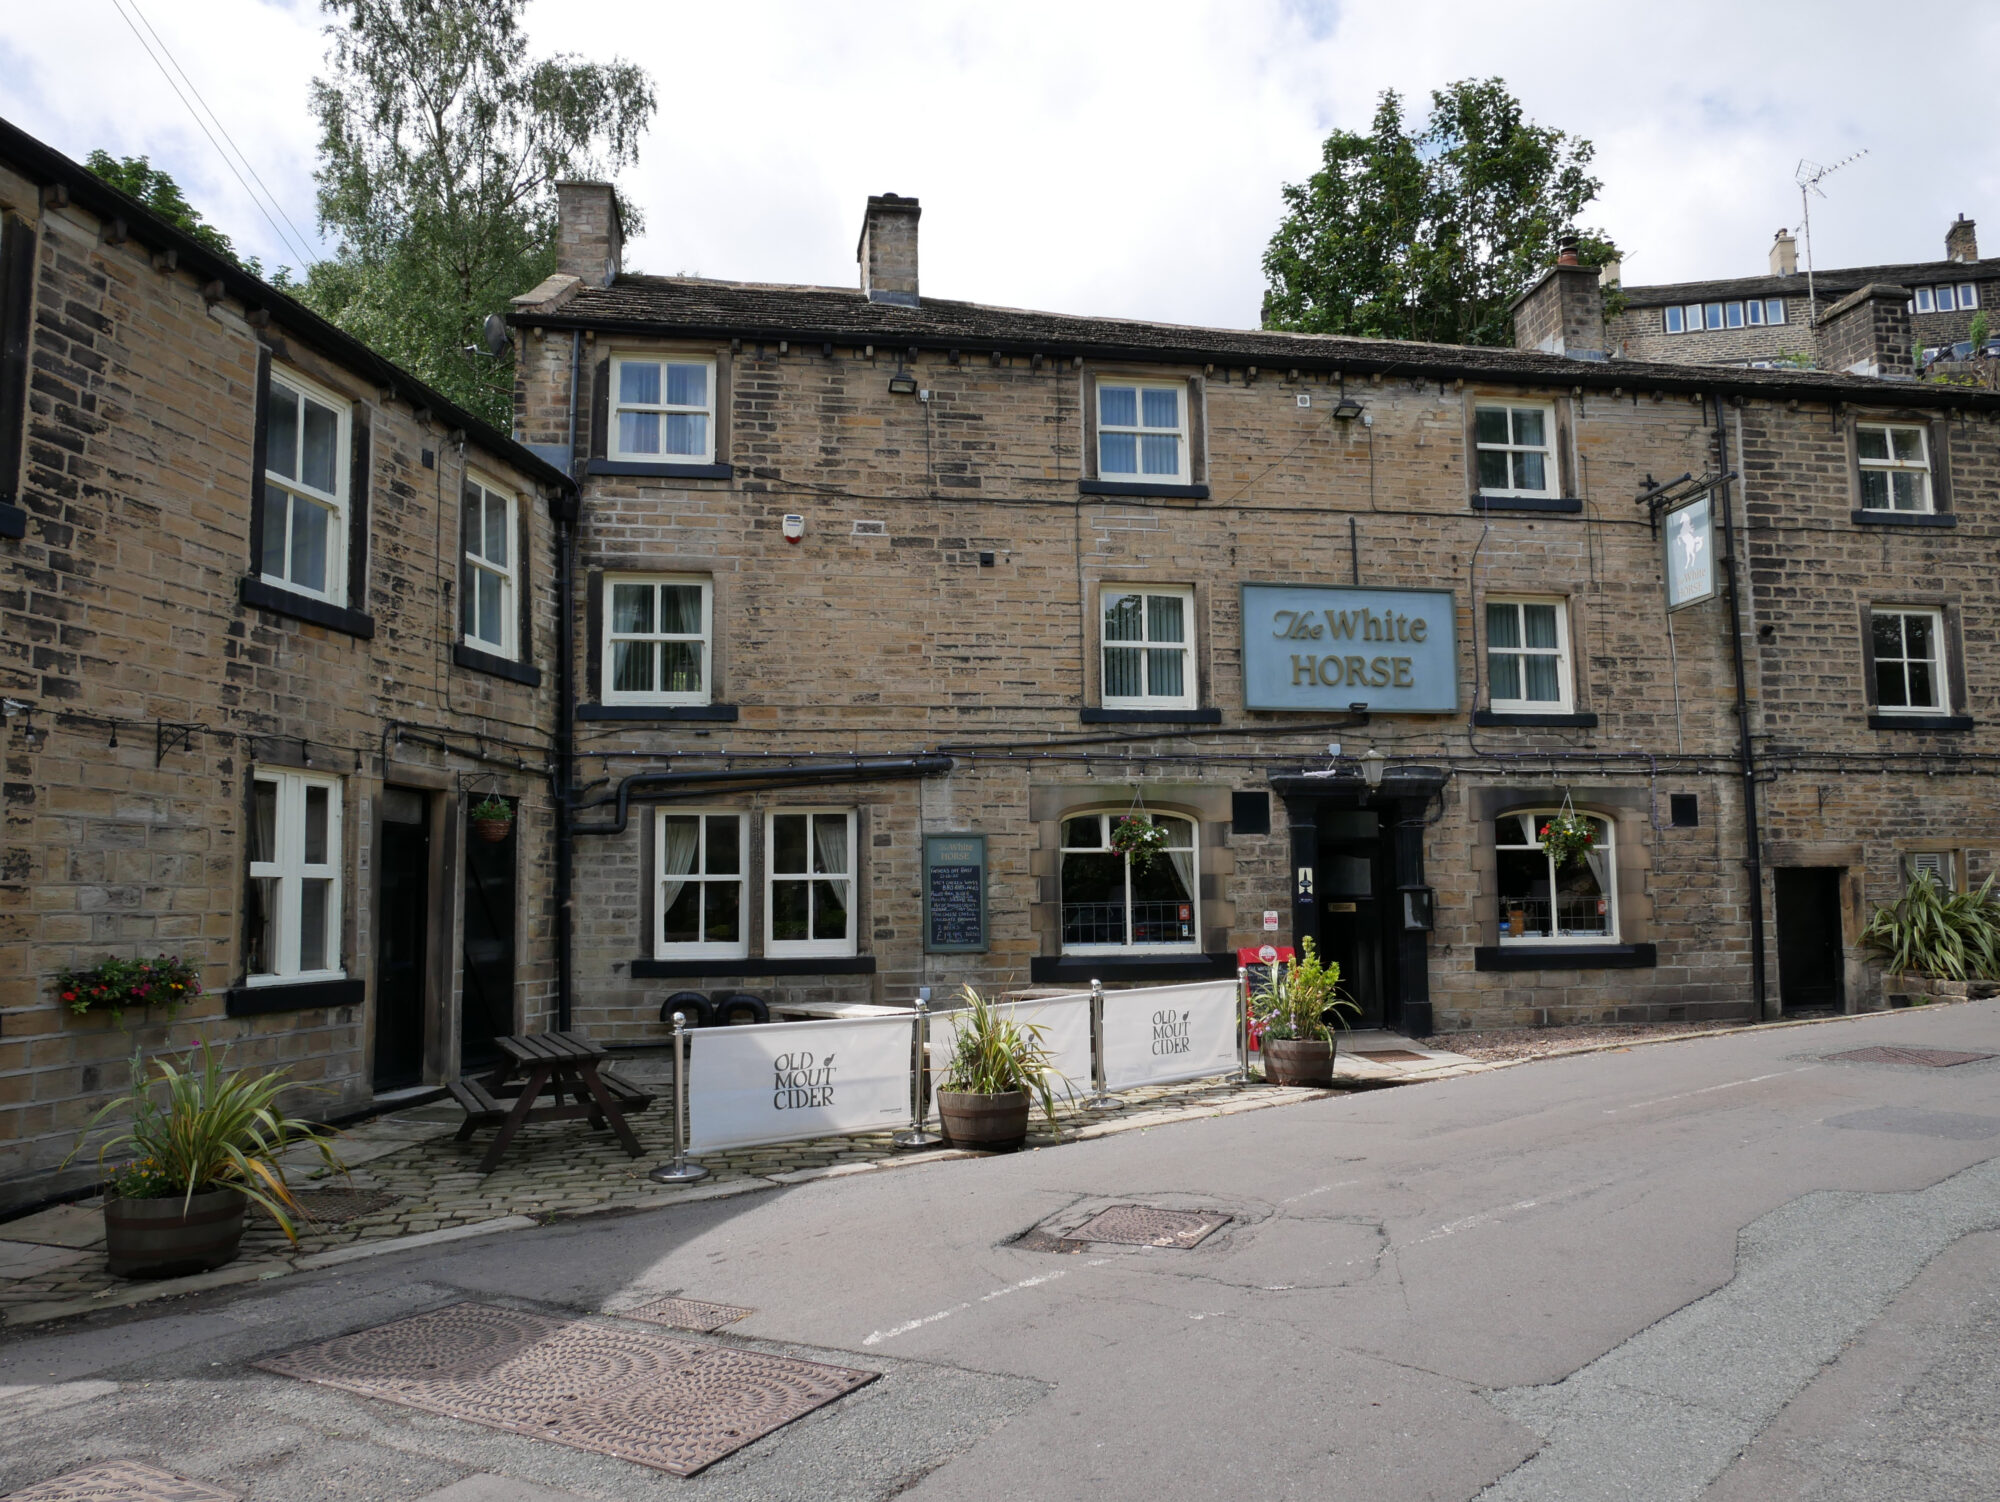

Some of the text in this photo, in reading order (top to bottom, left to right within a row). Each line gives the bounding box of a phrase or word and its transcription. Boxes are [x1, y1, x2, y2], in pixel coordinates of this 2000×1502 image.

[1272, 607, 1428, 642] The White
[1290, 654, 1415, 687] HORSE
[949, 842, 974, 851] White
[941, 852, 970, 860] HORSE
[1153, 1010, 1176, 1025] OLD
[1153, 1022, 1191, 1040] MOUT
[1152, 1037, 1191, 1055] CIDER
[774, 1052, 813, 1071] OLD
[774, 1067, 836, 1090] MOUT
[773, 1087, 834, 1110] CIDER
